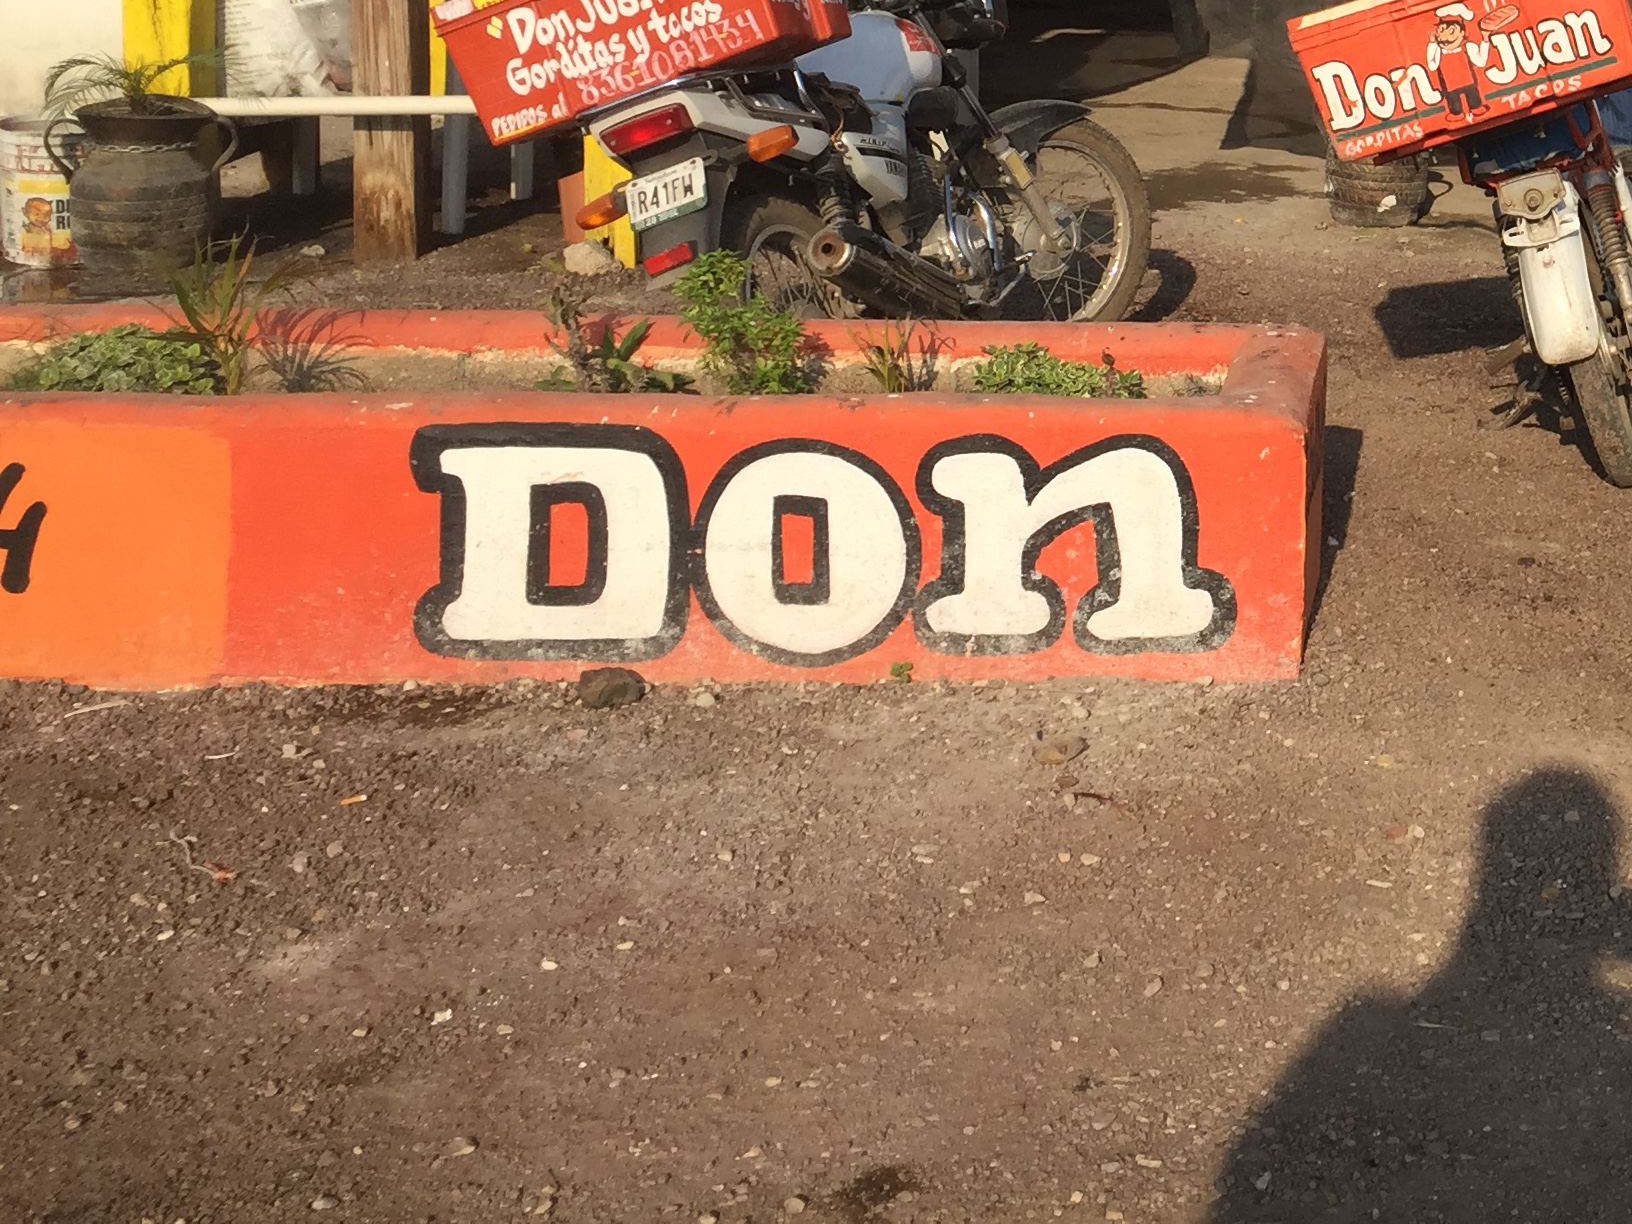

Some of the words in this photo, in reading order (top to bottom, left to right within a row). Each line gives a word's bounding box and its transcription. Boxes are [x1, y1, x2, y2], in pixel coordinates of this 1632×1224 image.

[506, 32, 627, 96] Gorditas
[626, 24, 651, 64] y
[1311, 60, 1446, 132] Don
[1484, 7, 1615, 85] Juan
[491, 104, 548, 138] PEDIDOS
[551, 91, 568, 119] al
[1501, 74, 1582, 110] TACOS
[637, 172, 695, 215] R41FW
[410, 421, 1238, 668] Don
